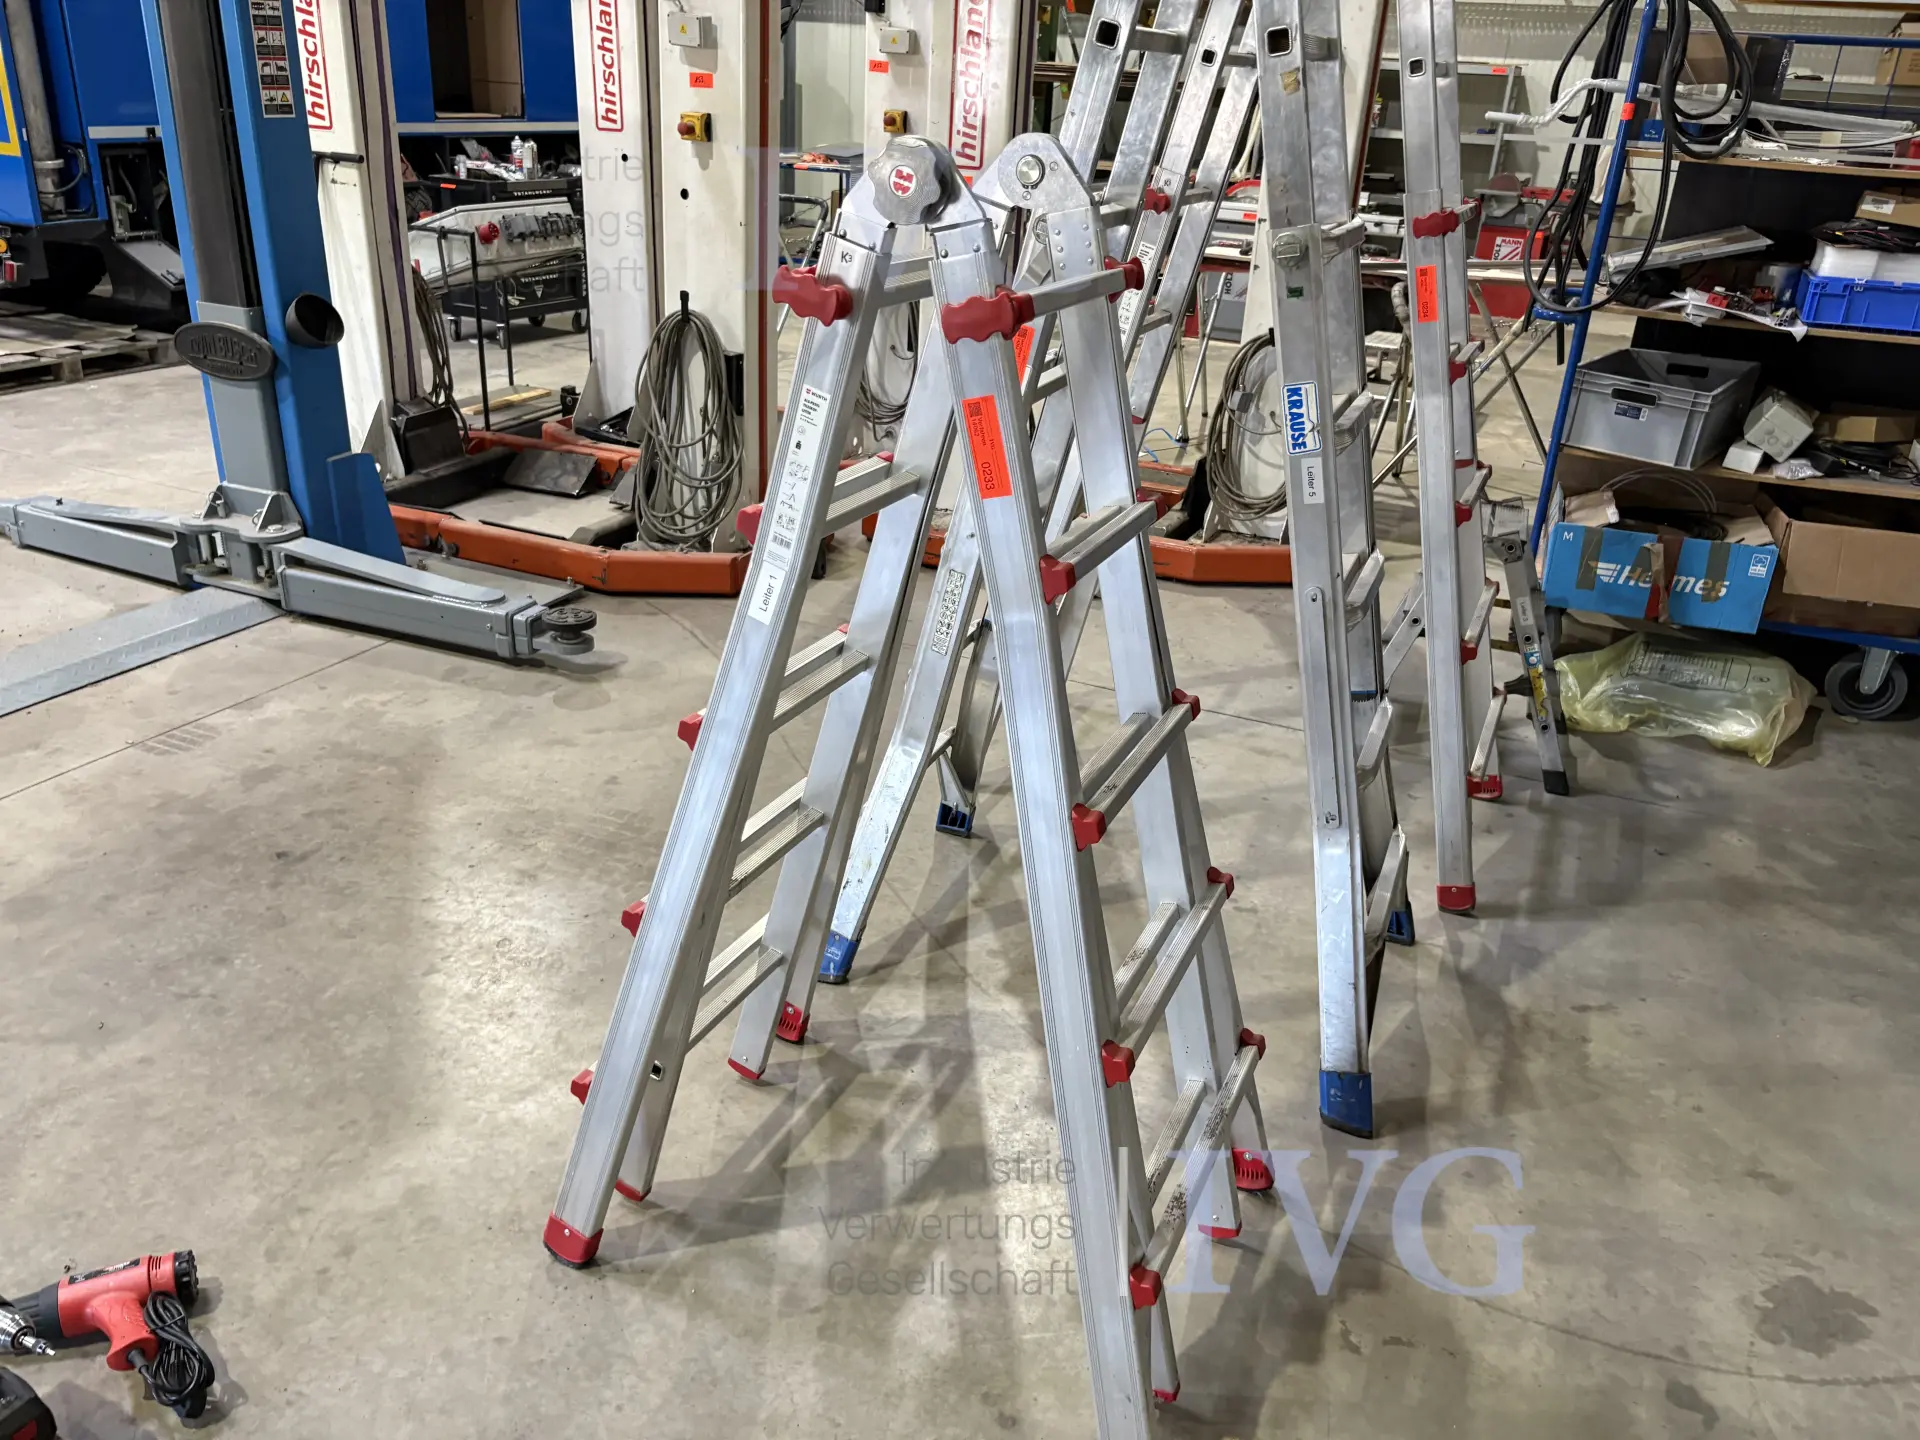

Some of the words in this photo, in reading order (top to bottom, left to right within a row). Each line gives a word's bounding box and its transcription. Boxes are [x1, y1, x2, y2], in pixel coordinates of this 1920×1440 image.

[956, 0, 984, 162] hirschlan
[1501, 238, 1523, 246] MANN
[1286, 386, 1308, 451] KRAUSE
[981, 461, 996, 491] 0233
[1306, 465, 1315, 490] Leiter
[1562, 531, 1573, 542] M
[1617, 565, 1730, 598] Hemes
[758, 582, 776, 613] Leiter
